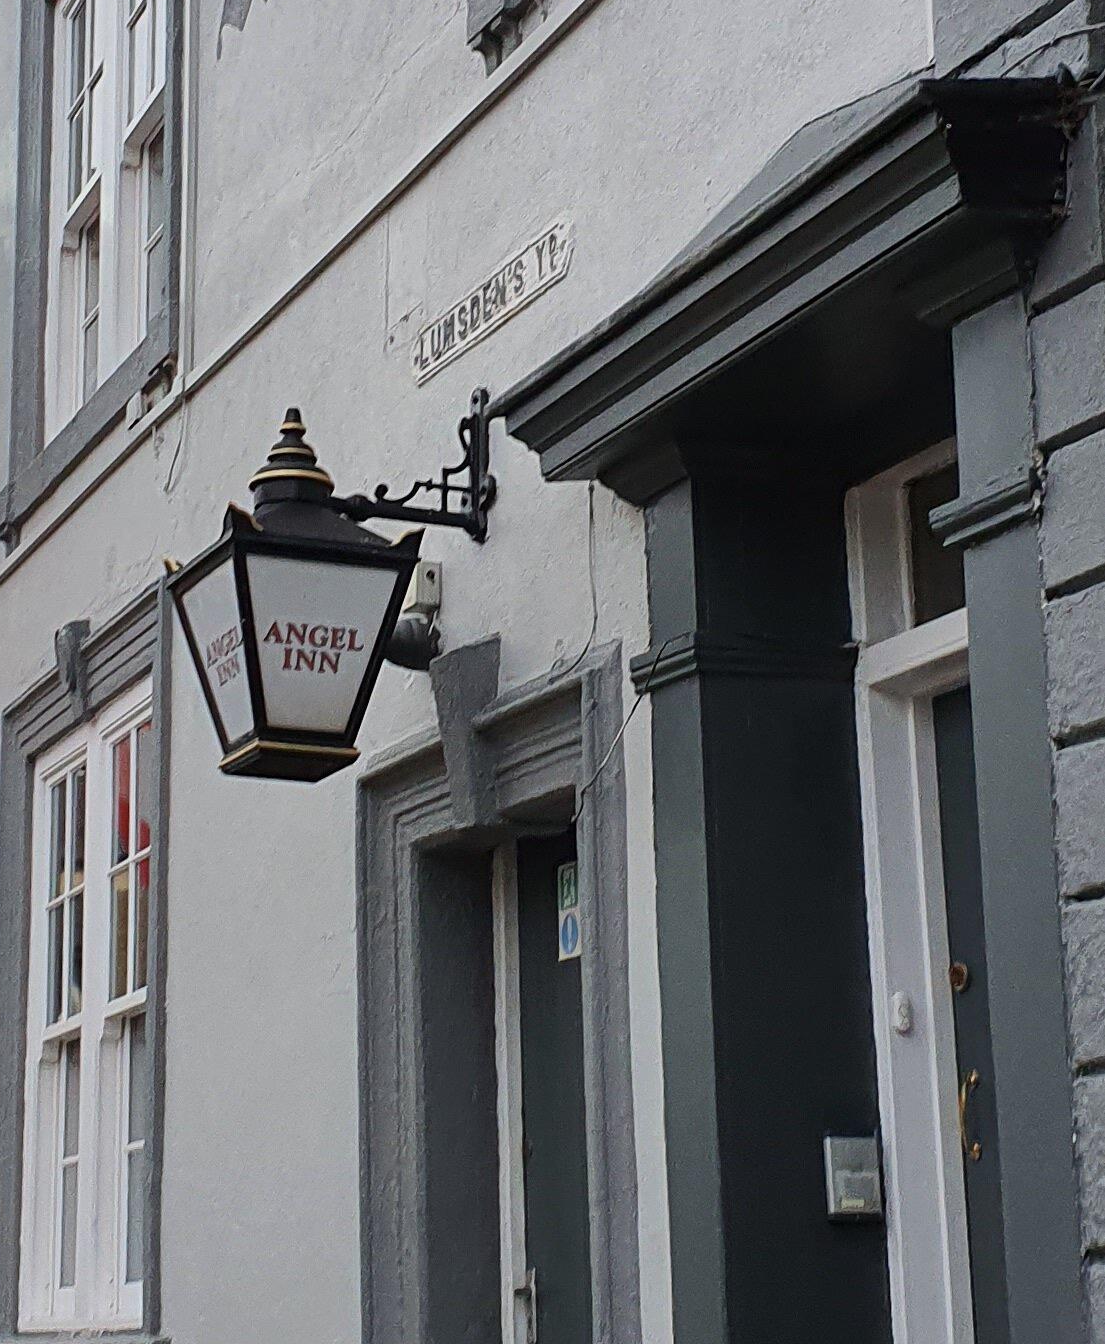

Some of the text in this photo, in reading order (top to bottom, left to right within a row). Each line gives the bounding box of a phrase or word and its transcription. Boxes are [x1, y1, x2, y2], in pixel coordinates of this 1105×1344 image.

[418, 259, 526, 370] LUMSDEN'S
[207, 625, 241, 668] ANGEL
[263, 620, 364, 652] ANGEL
[217, 653, 240, 687] INN
[282, 647, 342, 674] INN
